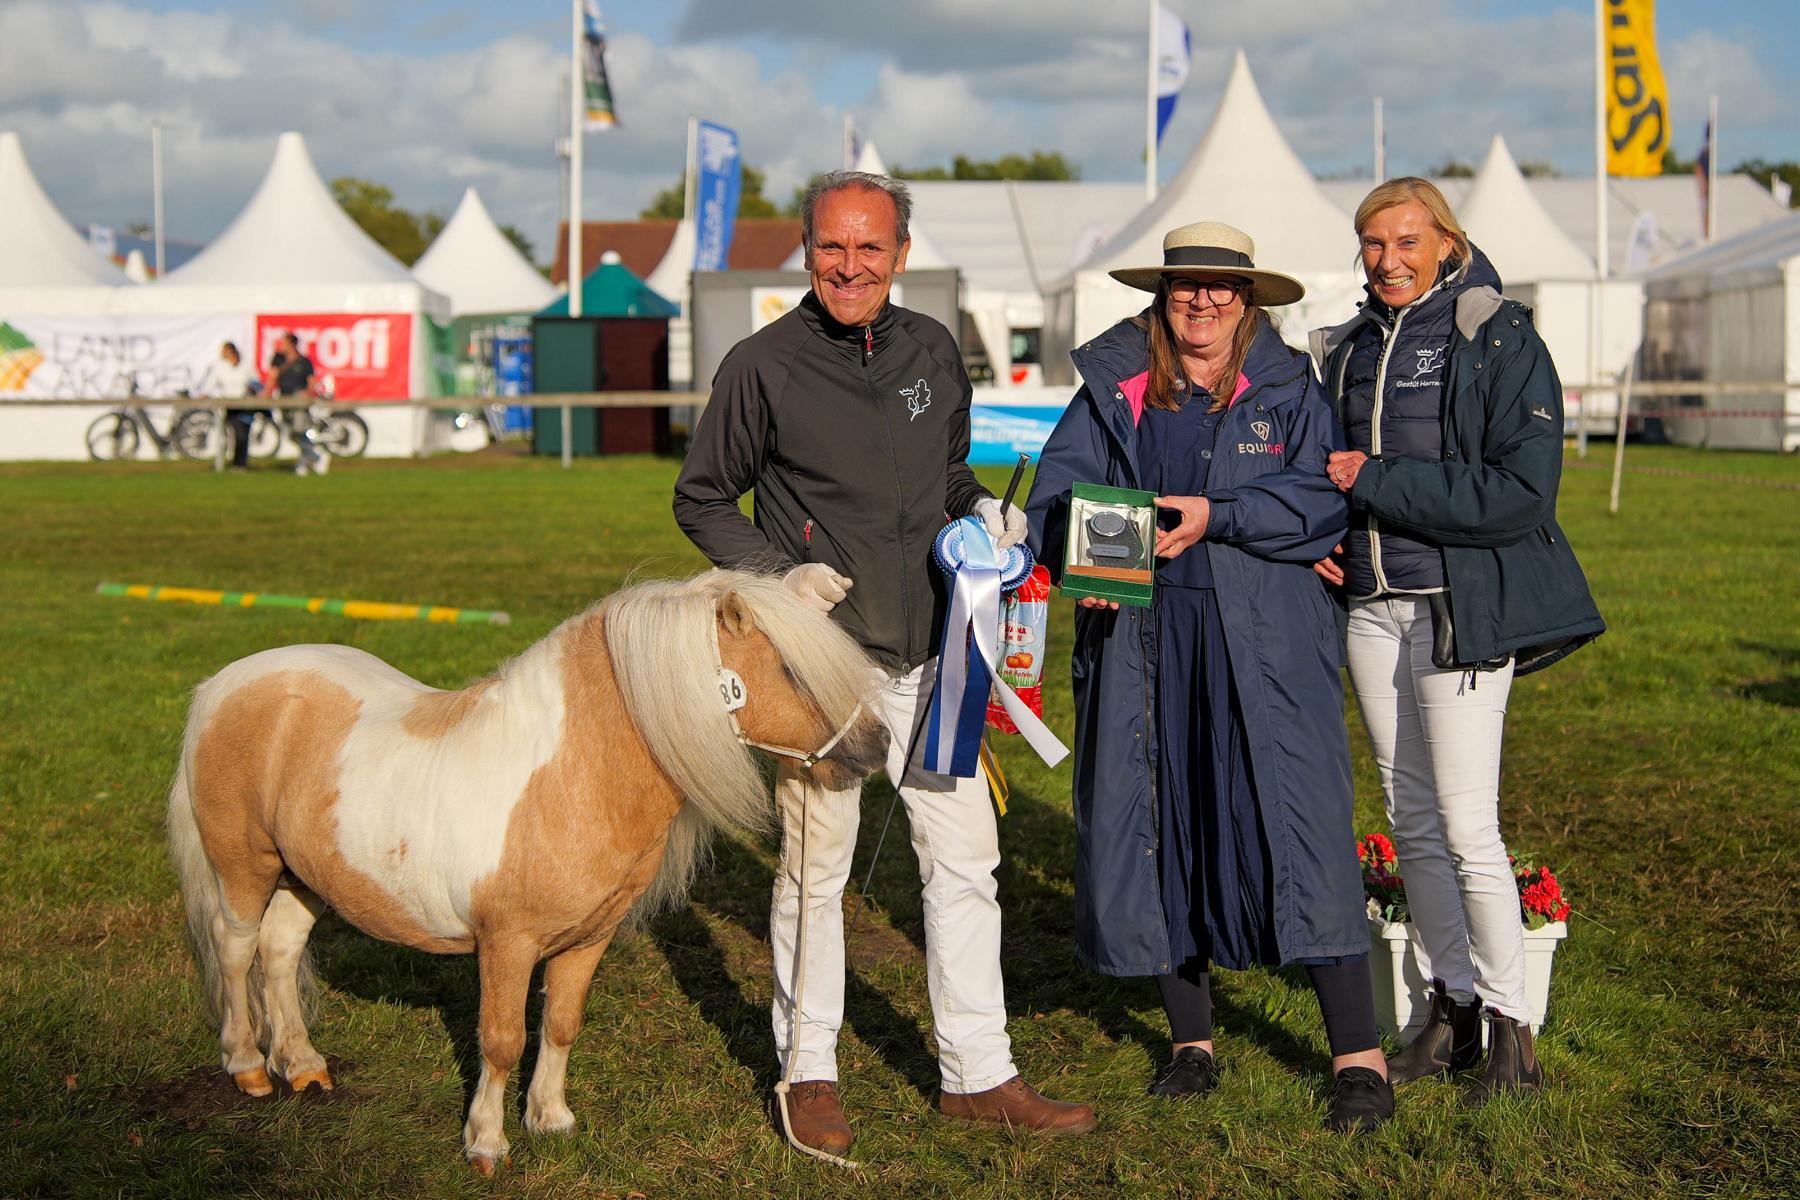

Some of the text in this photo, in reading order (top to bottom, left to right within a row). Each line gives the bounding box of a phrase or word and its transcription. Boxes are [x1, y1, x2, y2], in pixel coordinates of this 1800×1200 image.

[1610, 0, 1663, 153] San
[53, 334, 155, 363] LAND
[1238, 443, 1284, 455] EQUIDR
[719, 677, 742, 705] 86
